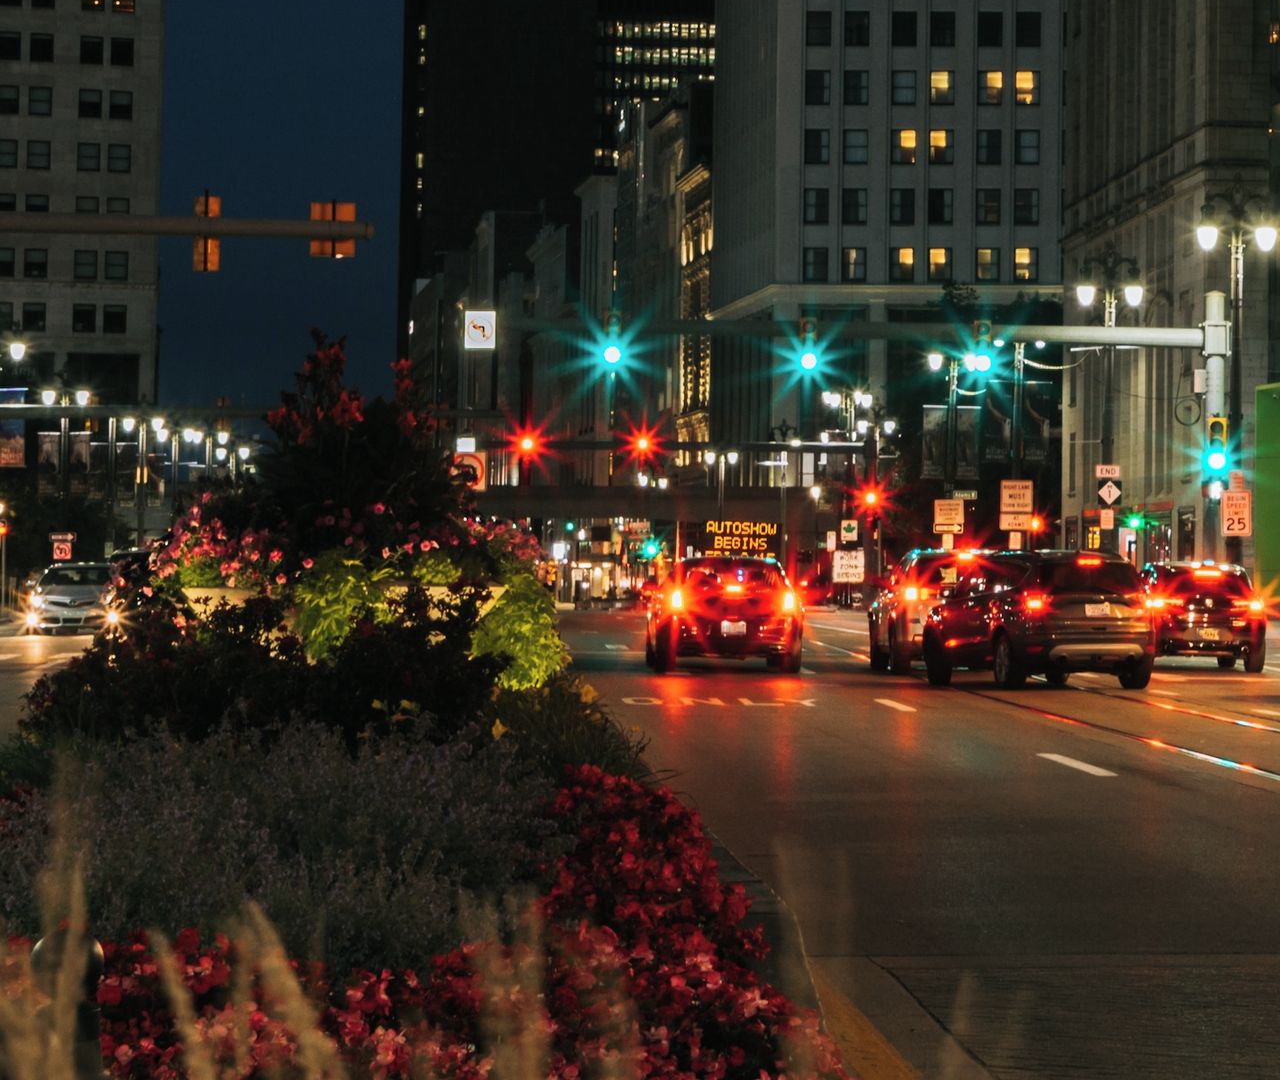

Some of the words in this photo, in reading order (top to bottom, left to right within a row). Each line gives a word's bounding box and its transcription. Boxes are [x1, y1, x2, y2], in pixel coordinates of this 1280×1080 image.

[1100, 467, 1116, 476] END
[706, 520, 777, 535] AUTOSHOW
[1226, 517, 1246, 531] 25
[714, 536, 768, 550] BEGINS
[621, 696, 816, 707] ONLY
